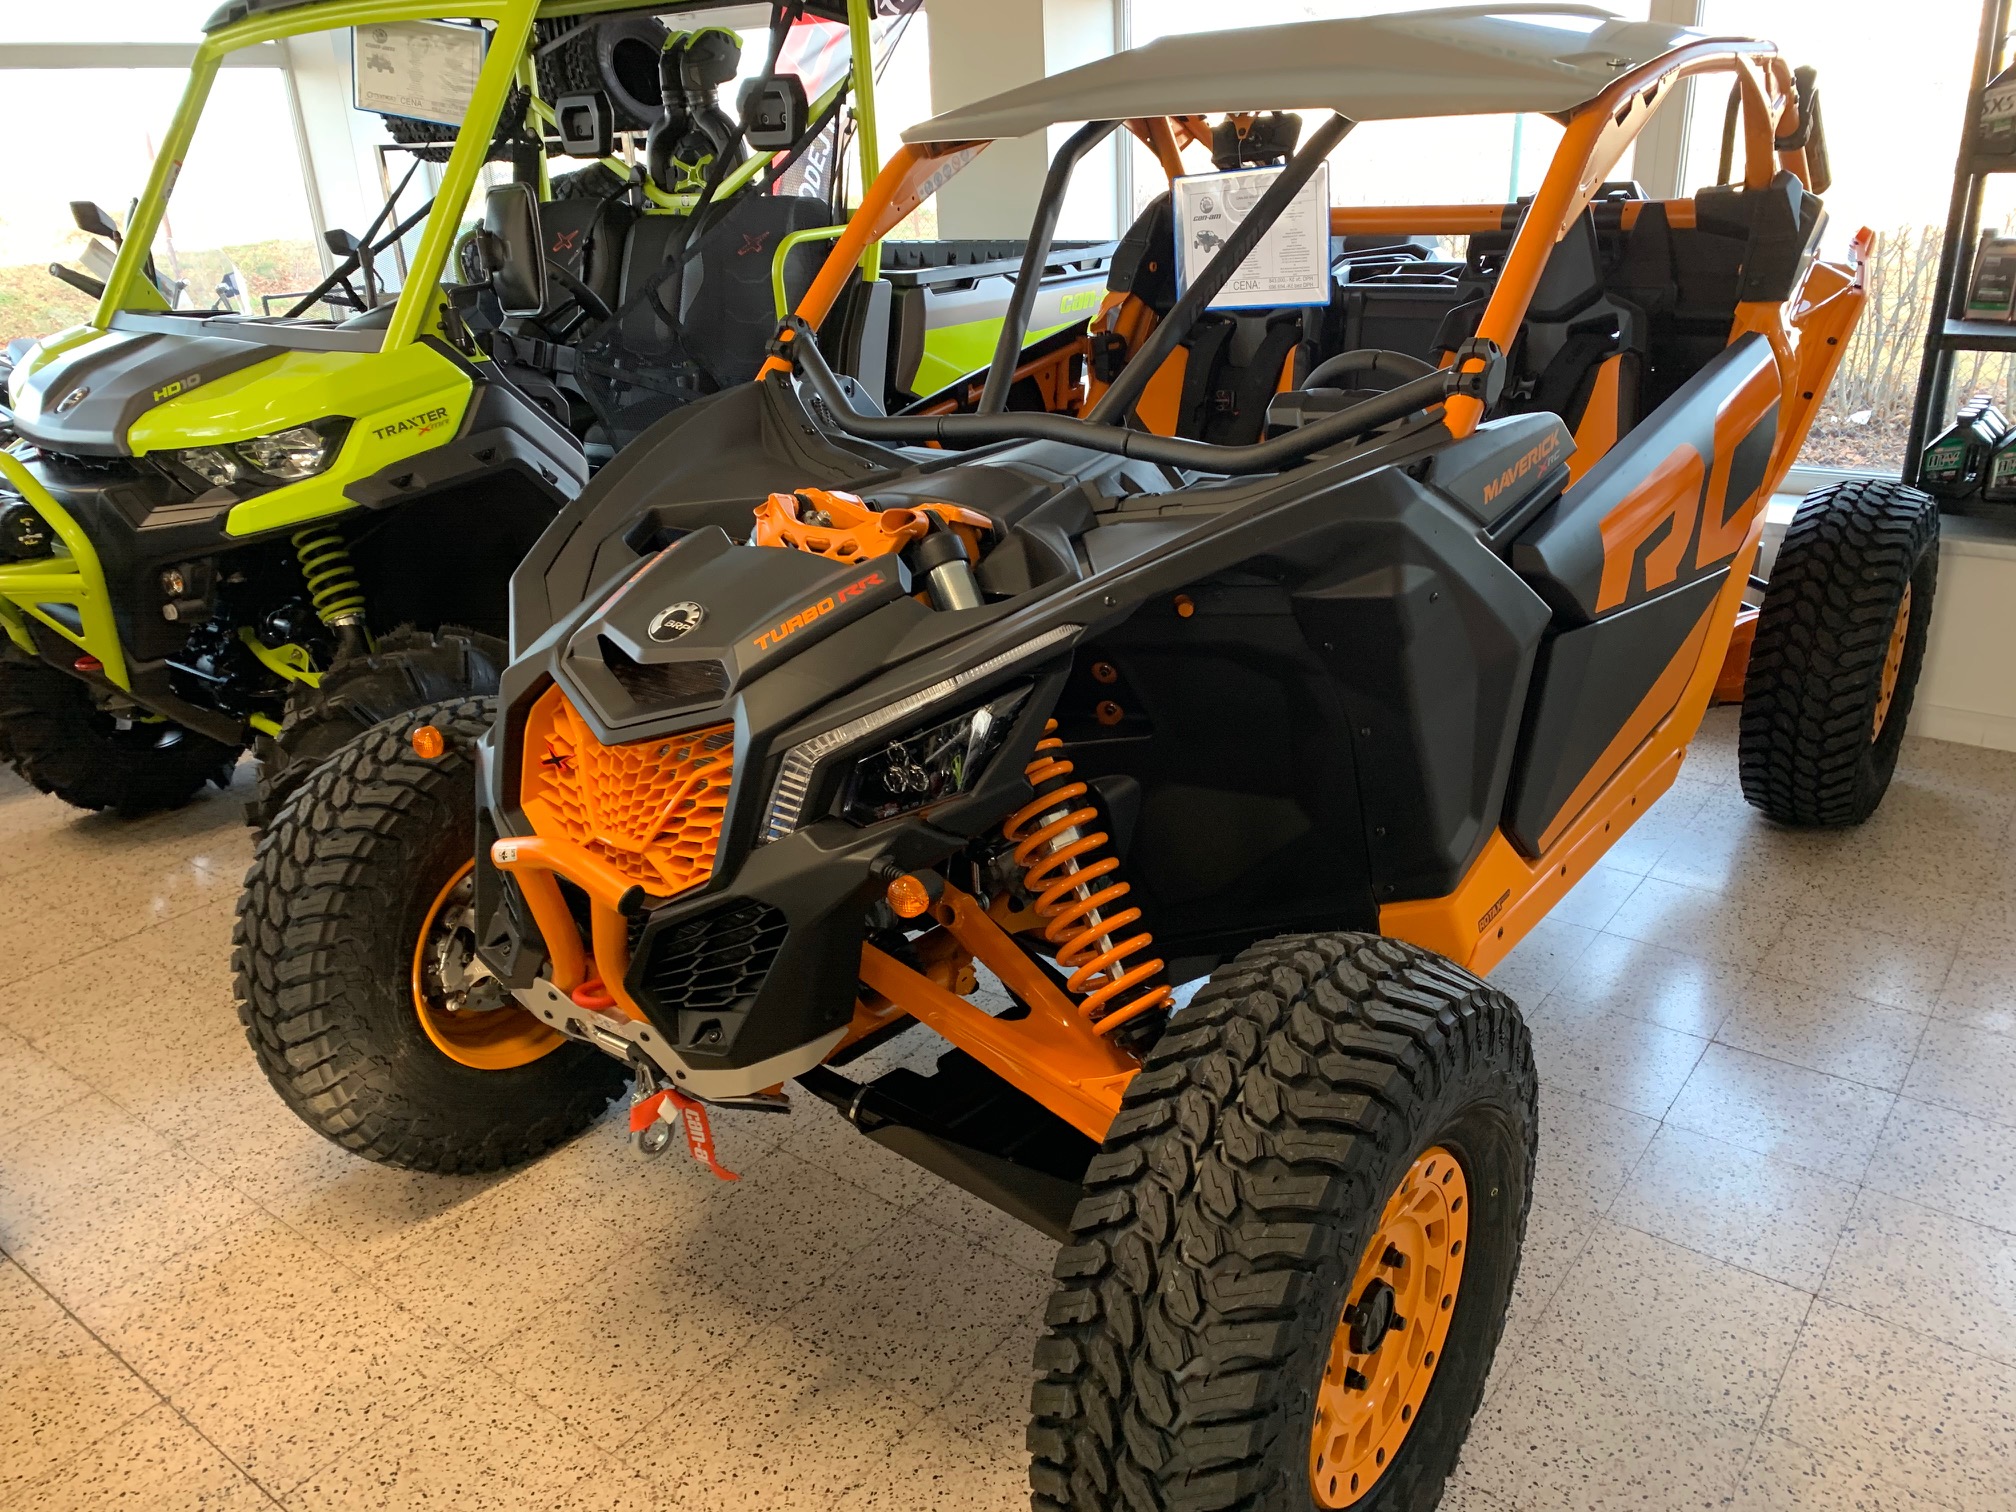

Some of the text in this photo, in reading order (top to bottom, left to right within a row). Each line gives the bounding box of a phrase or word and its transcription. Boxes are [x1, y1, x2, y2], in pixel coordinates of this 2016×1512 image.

[1060, 289, 1108, 314] can-
[1233, 280, 1261, 292] CENA:
[153, 373, 201, 402] HD10
[372, 407, 448, 439] TRAXTER
[1483, 428, 1560, 505] MAVERICK
[664, 619, 692, 631] BRP
[753, 573, 885, 650] TURBO RR
[1479, 899, 1503, 933] ROTAX
[684, 1107, 714, 1166] can-a
